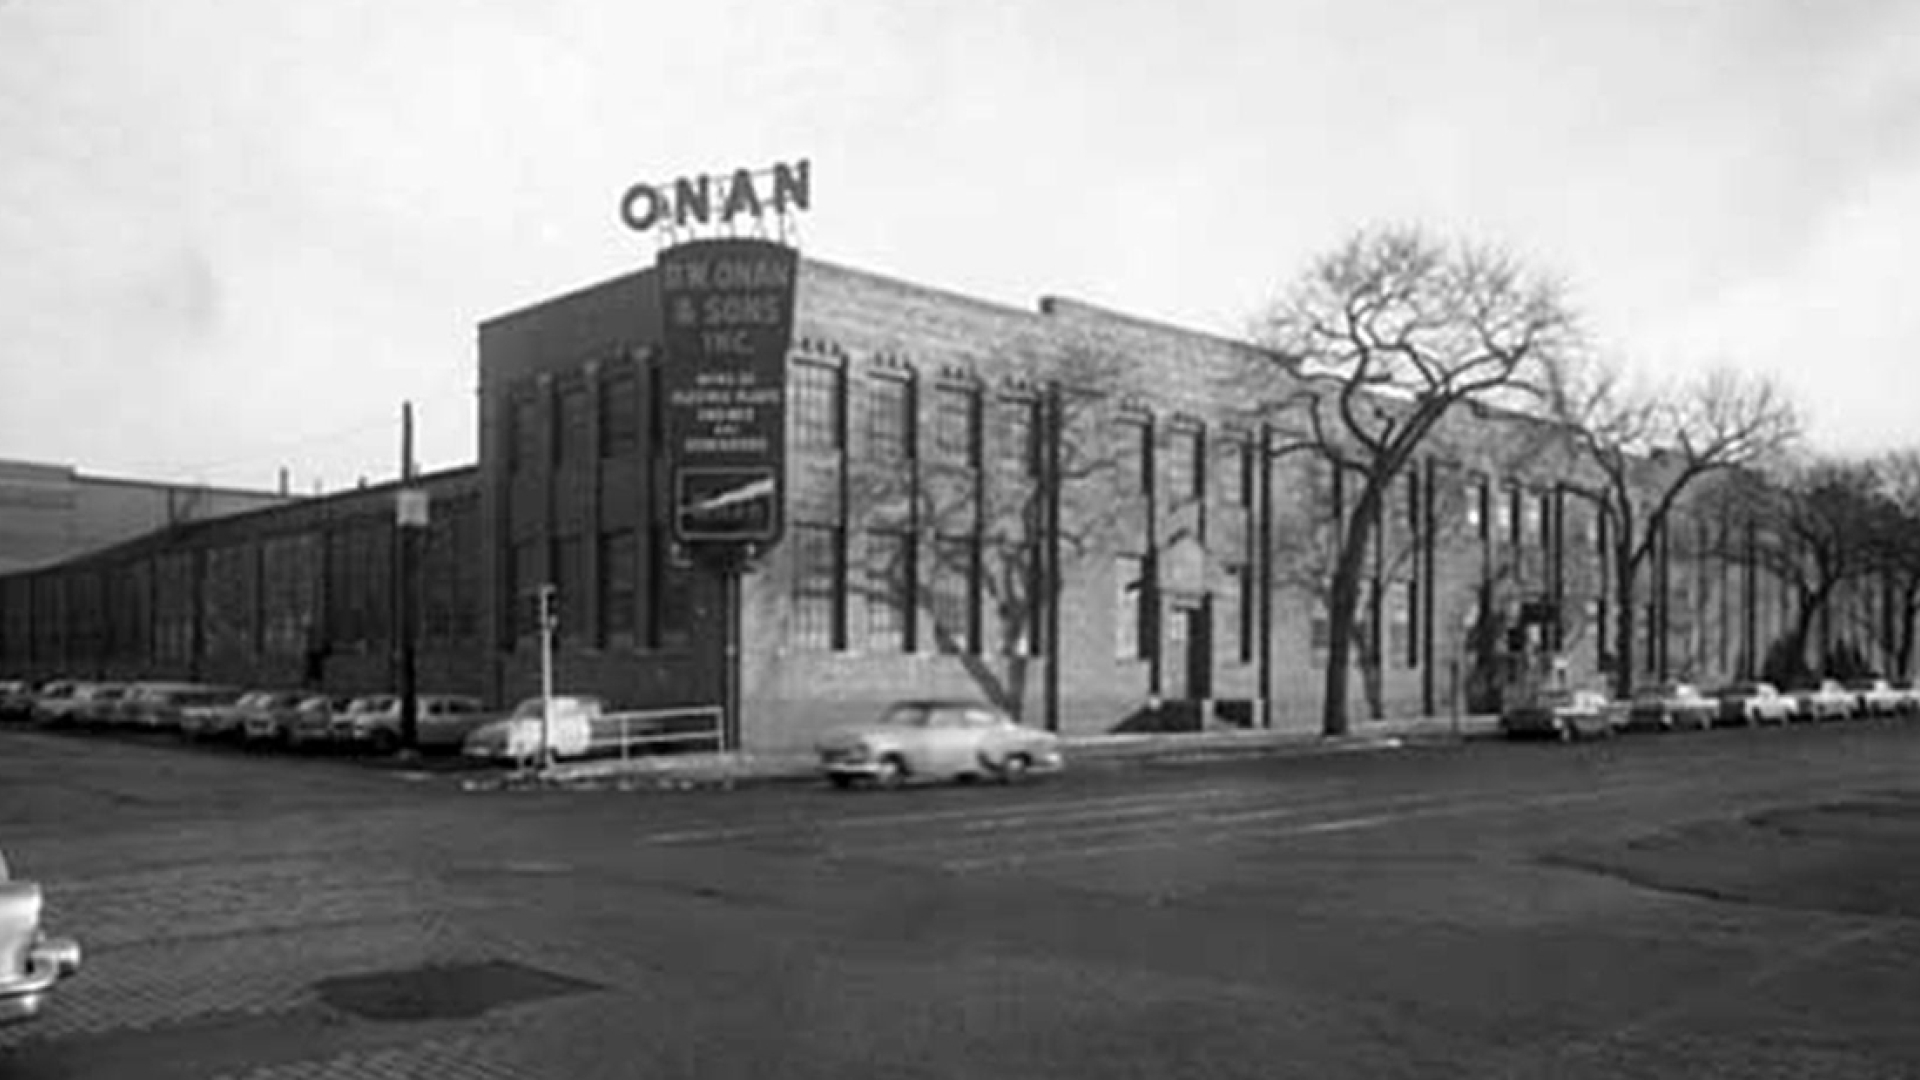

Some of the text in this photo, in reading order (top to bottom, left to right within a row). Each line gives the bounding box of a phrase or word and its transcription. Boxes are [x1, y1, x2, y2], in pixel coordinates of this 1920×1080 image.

[619, 158, 811, 232] ONAN
[714, 259, 789, 290] ONAN
[673, 295, 780, 326] & SONS
